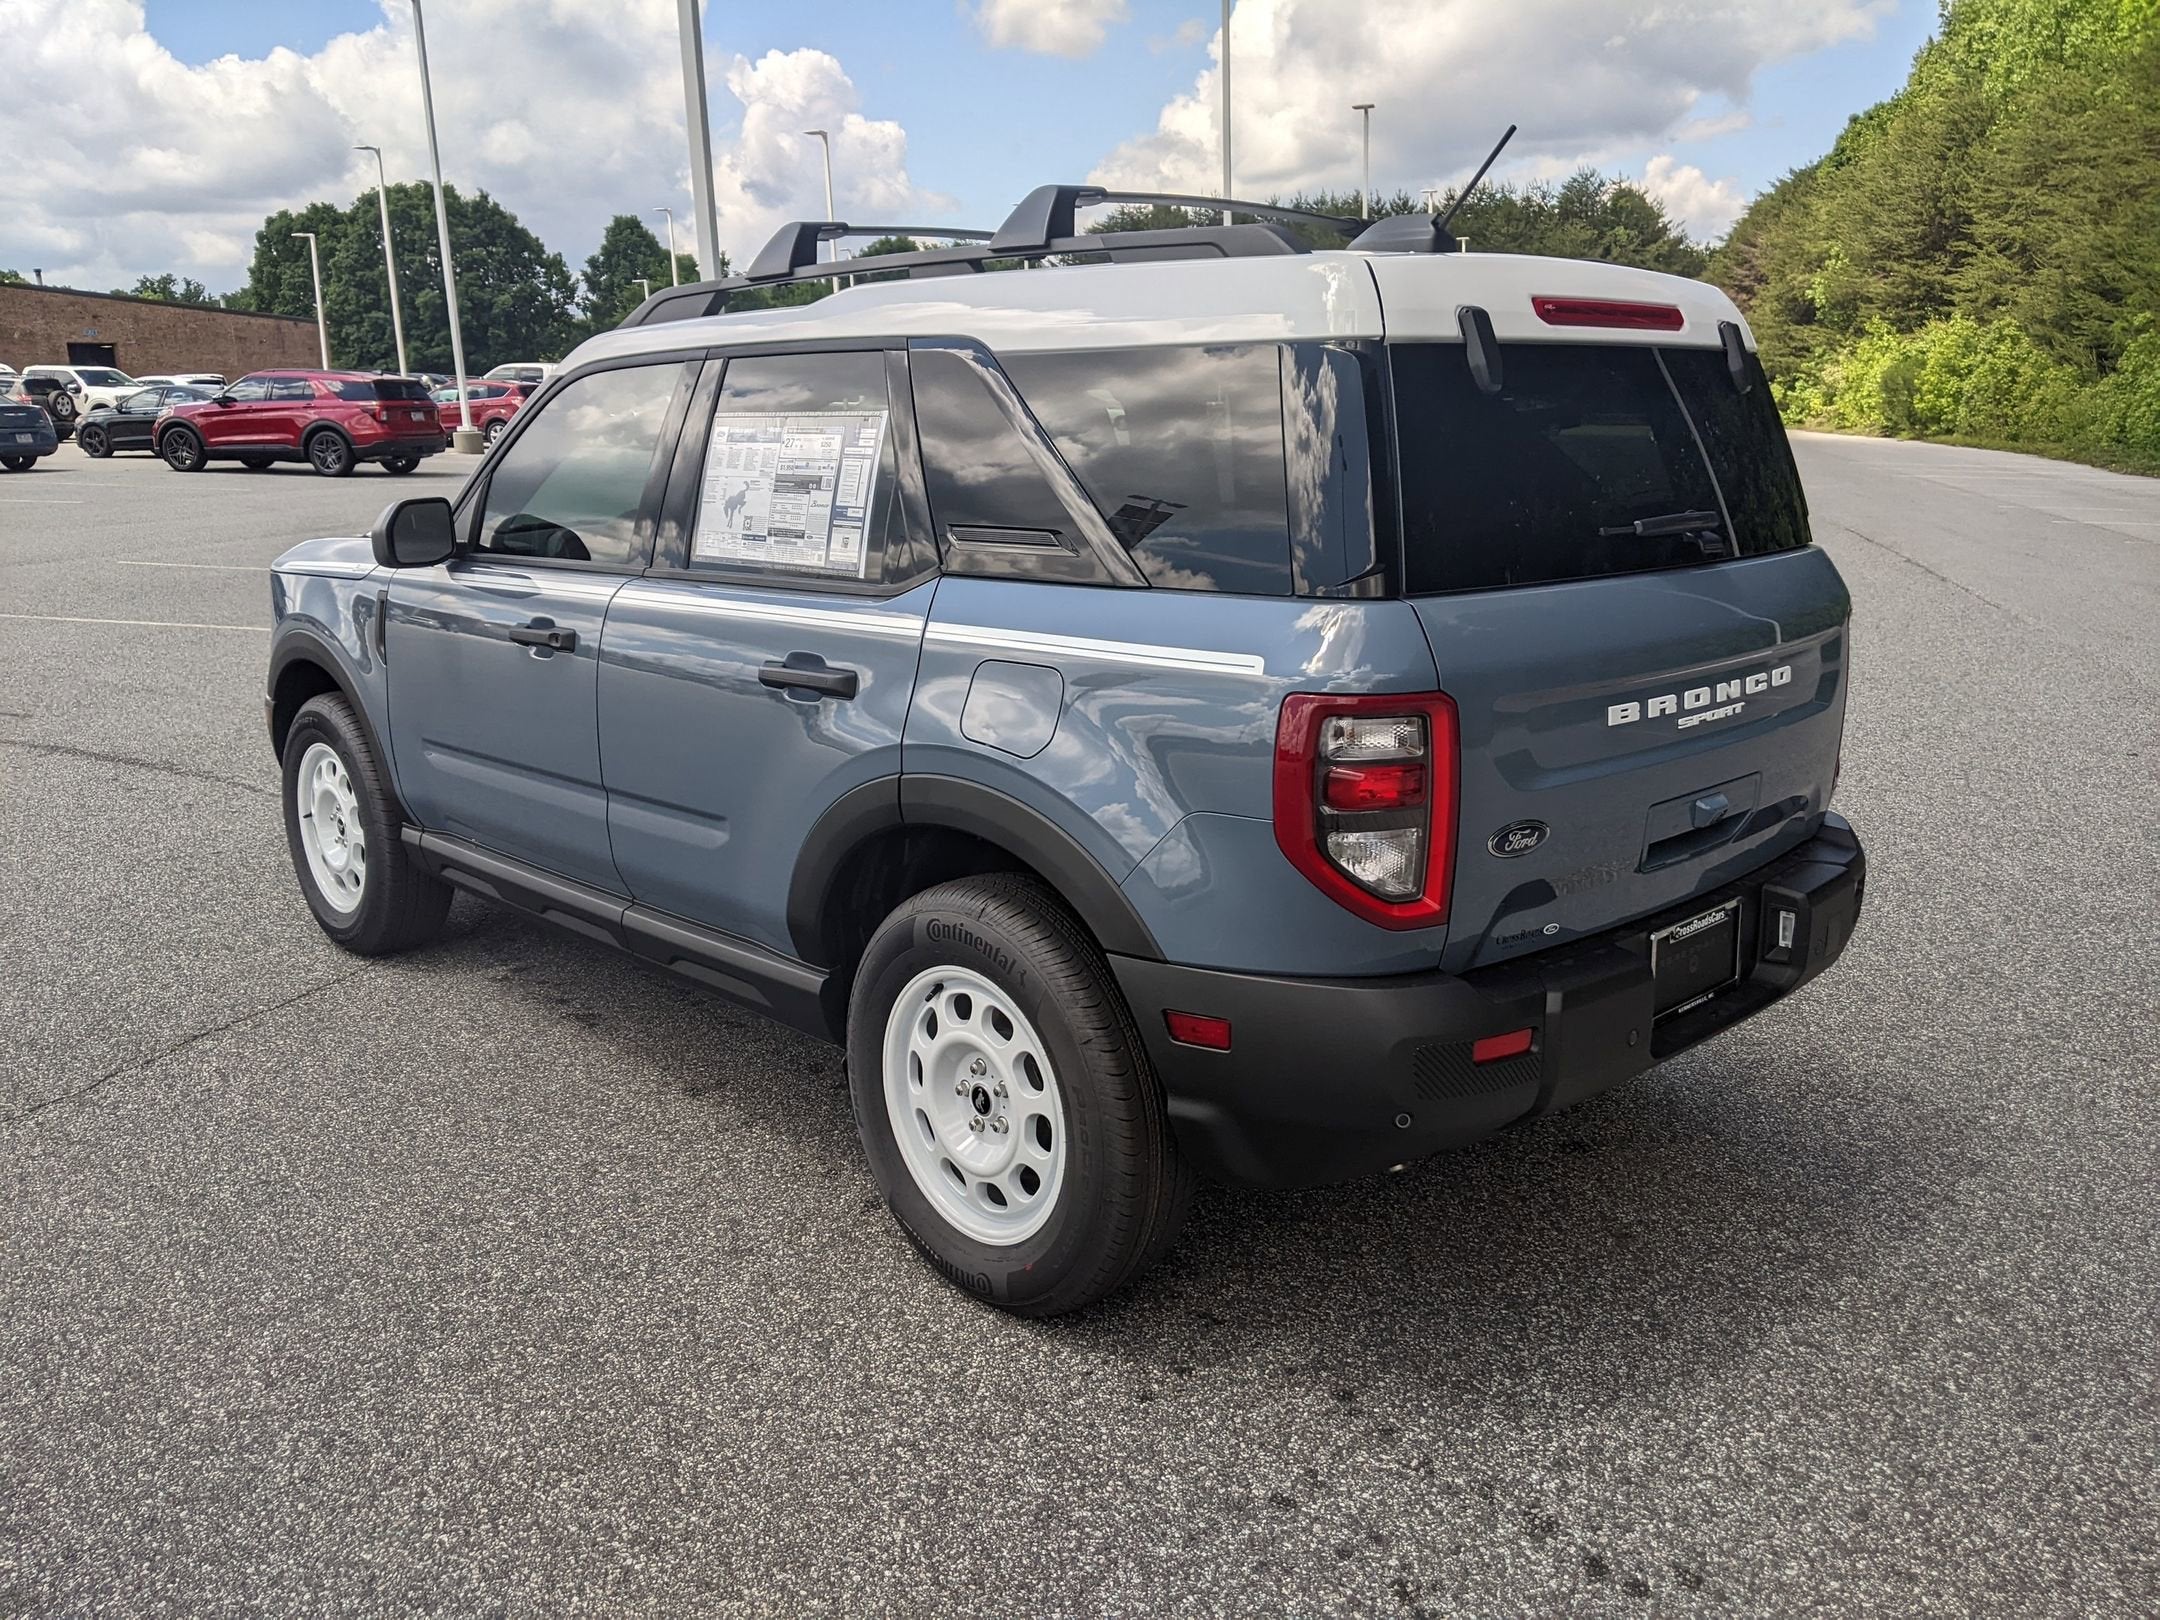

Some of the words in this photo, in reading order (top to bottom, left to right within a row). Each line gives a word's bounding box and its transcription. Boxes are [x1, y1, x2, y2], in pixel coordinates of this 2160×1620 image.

[784, 437, 796, 448] 27
[1607, 665, 1792, 727] BRONCO
[1677, 702, 1746, 729] SPORT
[1504, 829, 1539, 851] Ford
[926, 918, 1017, 975] Continental
